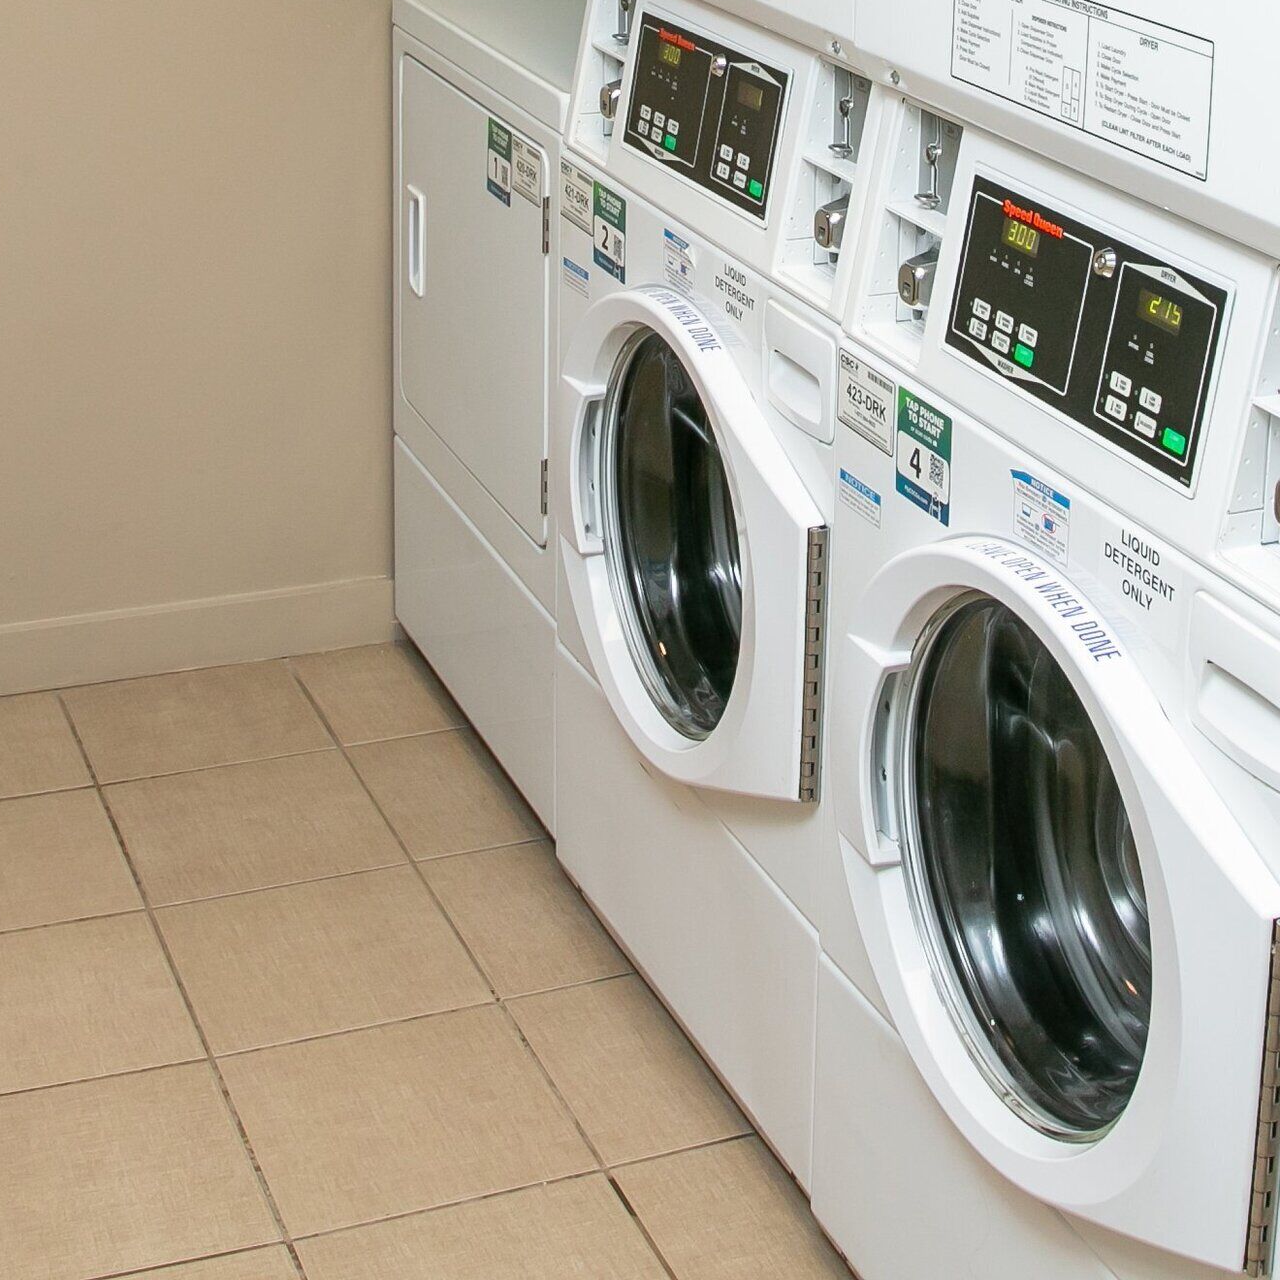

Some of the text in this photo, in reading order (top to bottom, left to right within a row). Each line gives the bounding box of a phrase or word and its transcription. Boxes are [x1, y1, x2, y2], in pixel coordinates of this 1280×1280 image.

[663, 44, 681, 65] 300
[1139, 37, 1159, 51] DRYER
[1002, 198, 1064, 239] Speed Queen
[601, 225, 609, 251] 2
[1007, 220, 1037, 251] 300
[724, 263, 747, 287] LIQUID
[1160, 270, 1177, 284] DRYER
[715, 275, 755, 311] DETERGENT
[725, 301, 744, 322] ONLY
[688, 327, 721, 352] DONE
[840, 353, 855, 370] CSC
[846, 383, 887, 423] 423-DRK
[905, 396, 945, 429] TAP PHONE
[908, 411, 942, 439] TO START
[909, 447, 921, 480] 4
[845, 472, 877, 503] NOTICE
[1120, 529, 1161, 567] LIQUID
[1104, 542, 1175, 603] DETERGENT
[1001, 556, 1049, 582] OPEN
[1034, 581, 1087, 619] WHEN
[1071, 620, 1122, 662] DONE
[1121, 579, 1153, 612] ONLY
